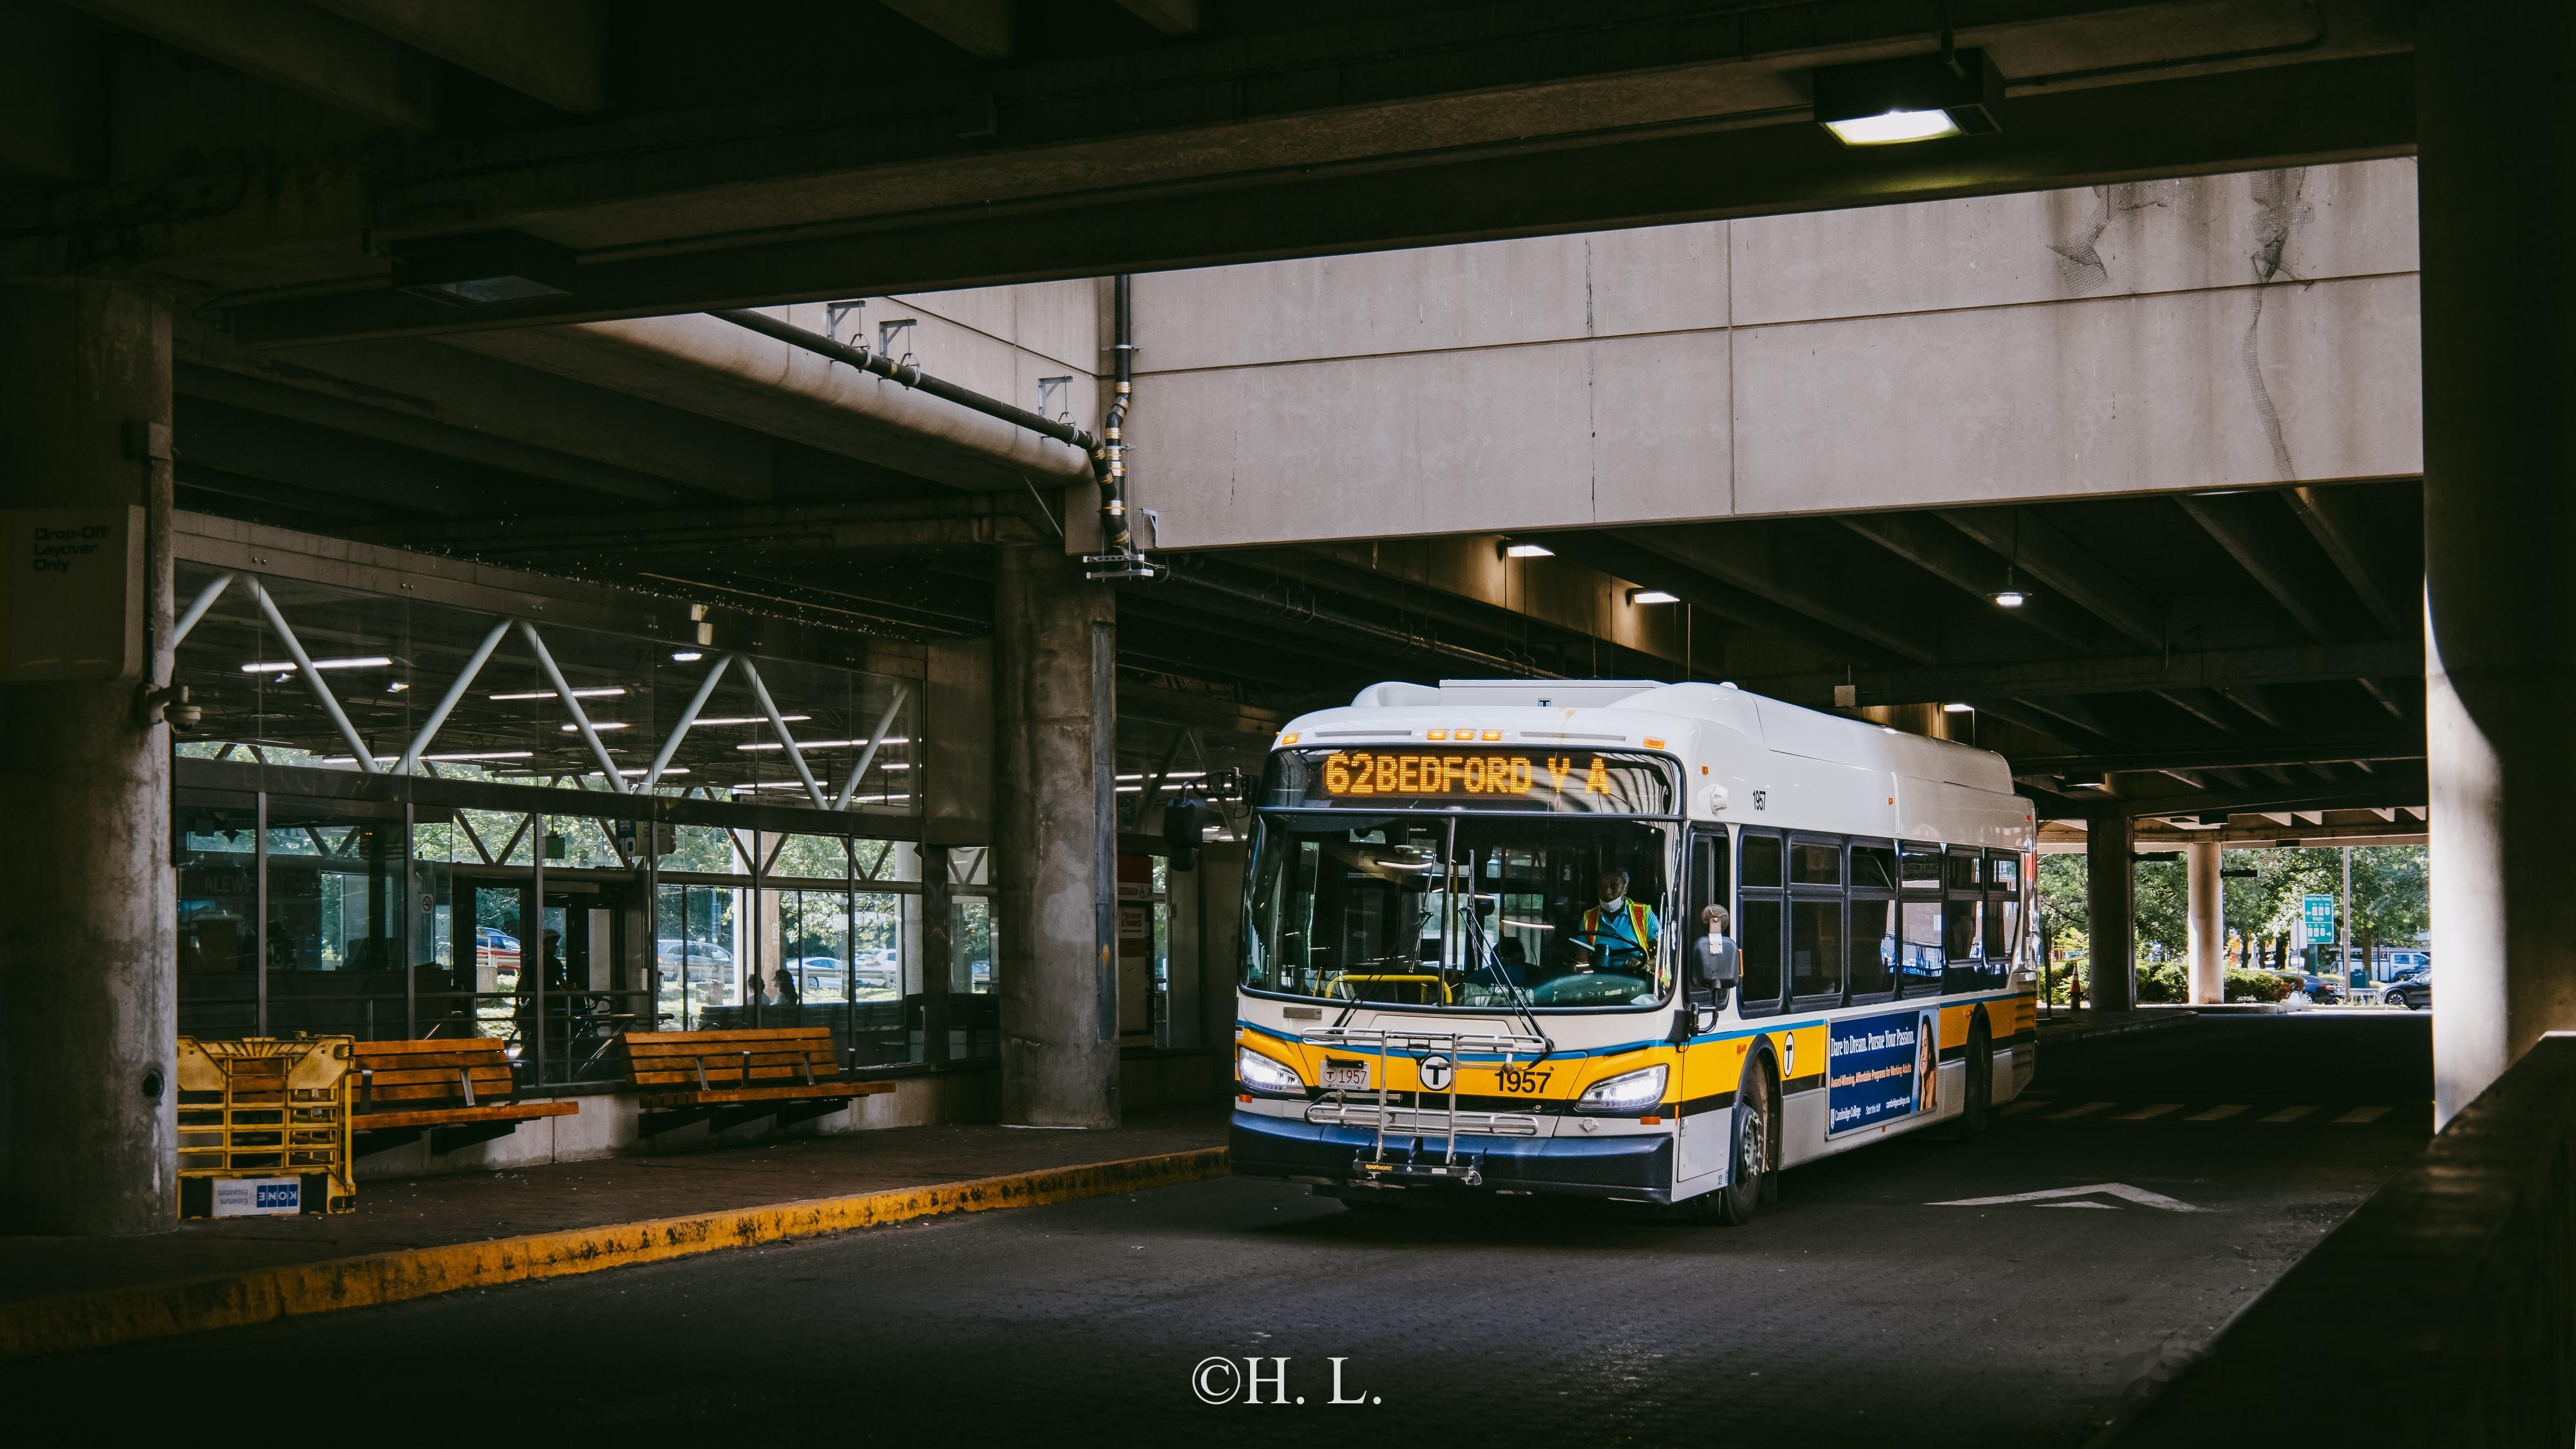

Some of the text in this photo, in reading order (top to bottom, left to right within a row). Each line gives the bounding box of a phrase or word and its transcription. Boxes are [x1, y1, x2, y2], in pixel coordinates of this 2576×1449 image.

[34, 526, 111, 541] Drop-Off/
[34, 542, 99, 557] Layover
[34, 558, 70, 573] Only
[1585, 757, 1609, 795] A
[1752, 790, 1766, 811] 1957
[618, 837, 636, 857] 10
[203, 876, 256, 894] ALEWIF
[1830, 1026, 1915, 1057] Dare to Dream. Pursue Your Passion.
[1339, 1069, 1367, 1084] 1957
[1425, 1064, 1448, 1085] T
[1494, 1069, 1551, 1094] 1957
[1871, 1069, 1886, 1082] Programs
[1890, 1065, 1902, 1077] Working
[1902, 1063, 1912, 1074] Adults
[1835, 1105, 1861, 1122] Cambridge College
[258, 1189, 297, 1202] KONE
